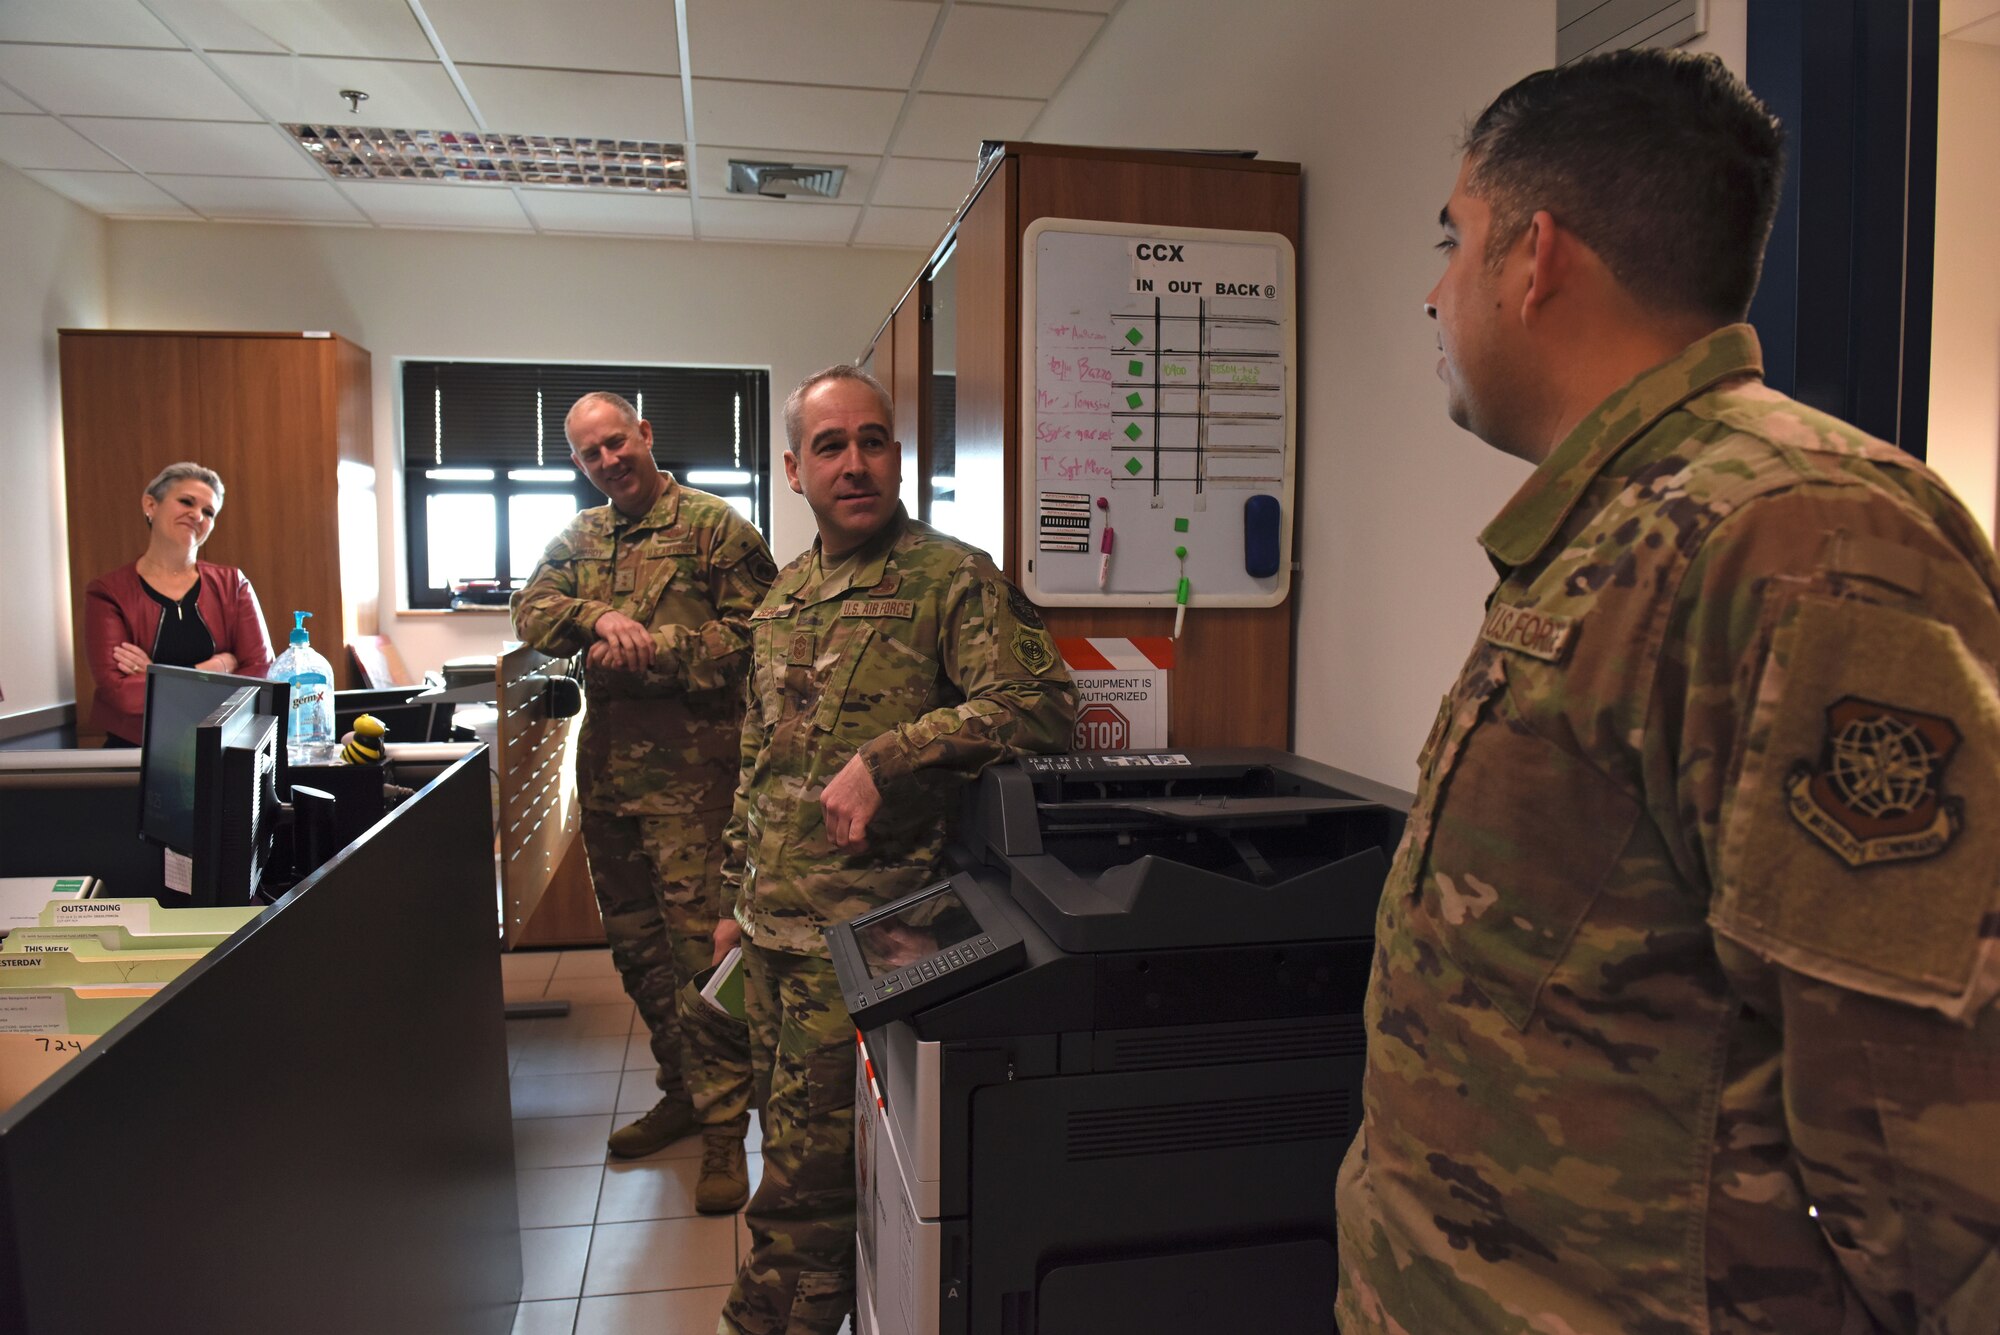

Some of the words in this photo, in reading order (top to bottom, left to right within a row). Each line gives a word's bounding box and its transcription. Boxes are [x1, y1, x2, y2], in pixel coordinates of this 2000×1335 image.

[1136, 243, 1184, 262] CCX
[1136, 279, 1154, 292] IN
[1168, 280, 1202, 294] OUT
[1215, 282, 1260, 297] BACK
[1264, 284, 1276, 298] @
[861, 602, 879, 615] AIR
[880, 601, 911, 617] FORCE
[1077, 679, 1139, 689] EQUIPMENT
[1142, 679, 1152, 688] IS
[1080, 691, 1148, 702] AUTHORIZED
[1075, 721, 1122, 750] STOP
[61, 904, 121, 912] OUTSTANDING
[24, 945, 43, 953] THIS
[35, 1038, 82, 1052] 724
